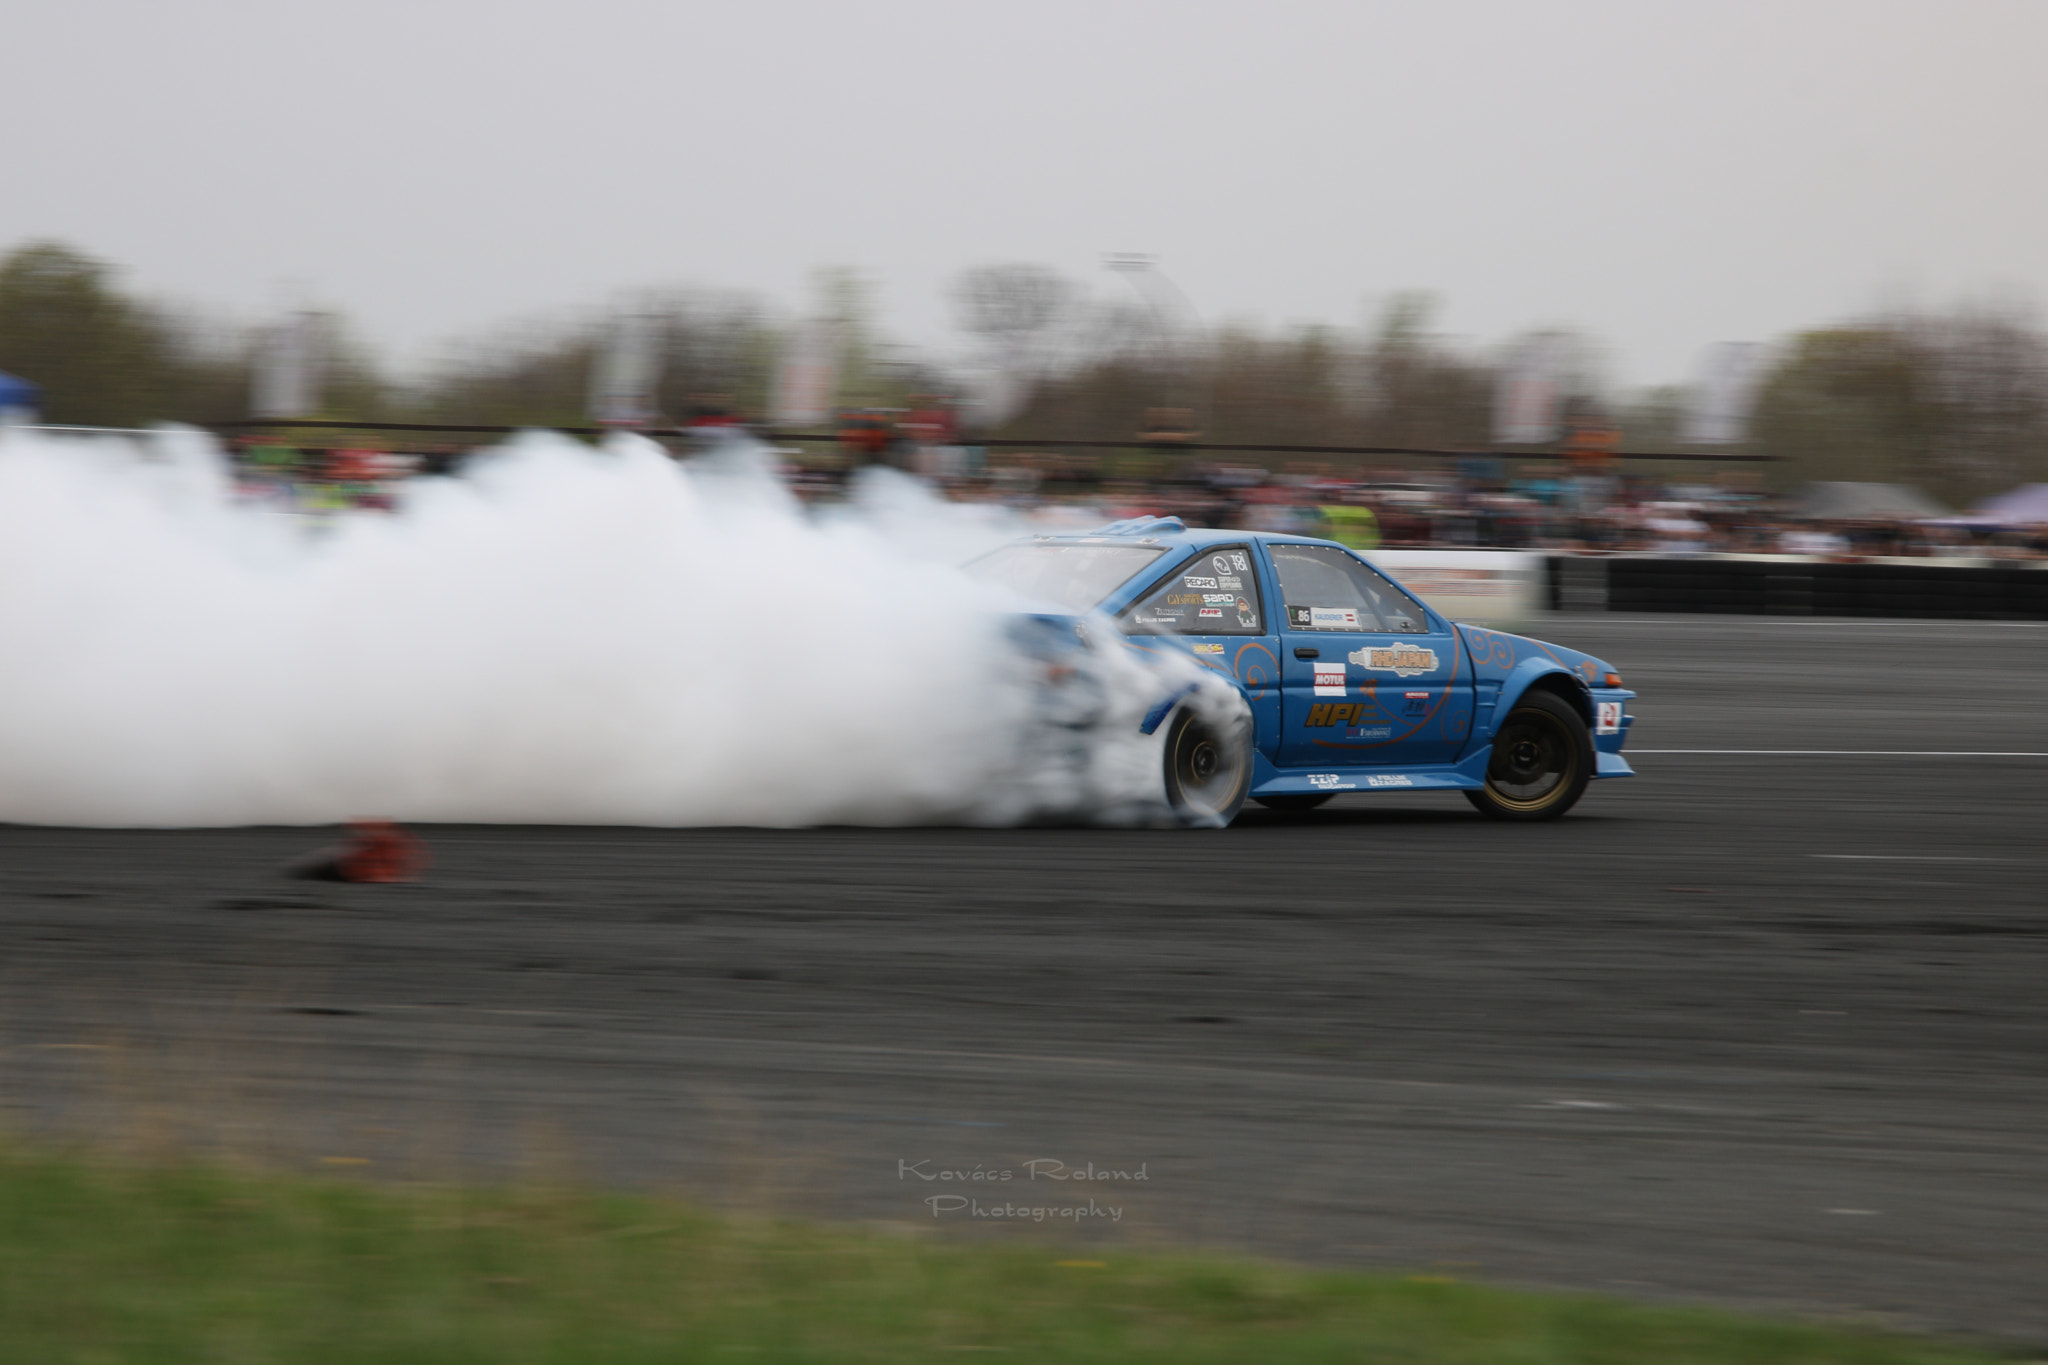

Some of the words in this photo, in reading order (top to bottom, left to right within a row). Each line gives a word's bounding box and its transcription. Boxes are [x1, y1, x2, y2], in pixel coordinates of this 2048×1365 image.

[1185, 577, 1216, 587] RECARO
[1297, 610, 1310, 622] 86
[1315, 675, 1345, 685] MOTUL
[1304, 703, 1365, 727] HPI
